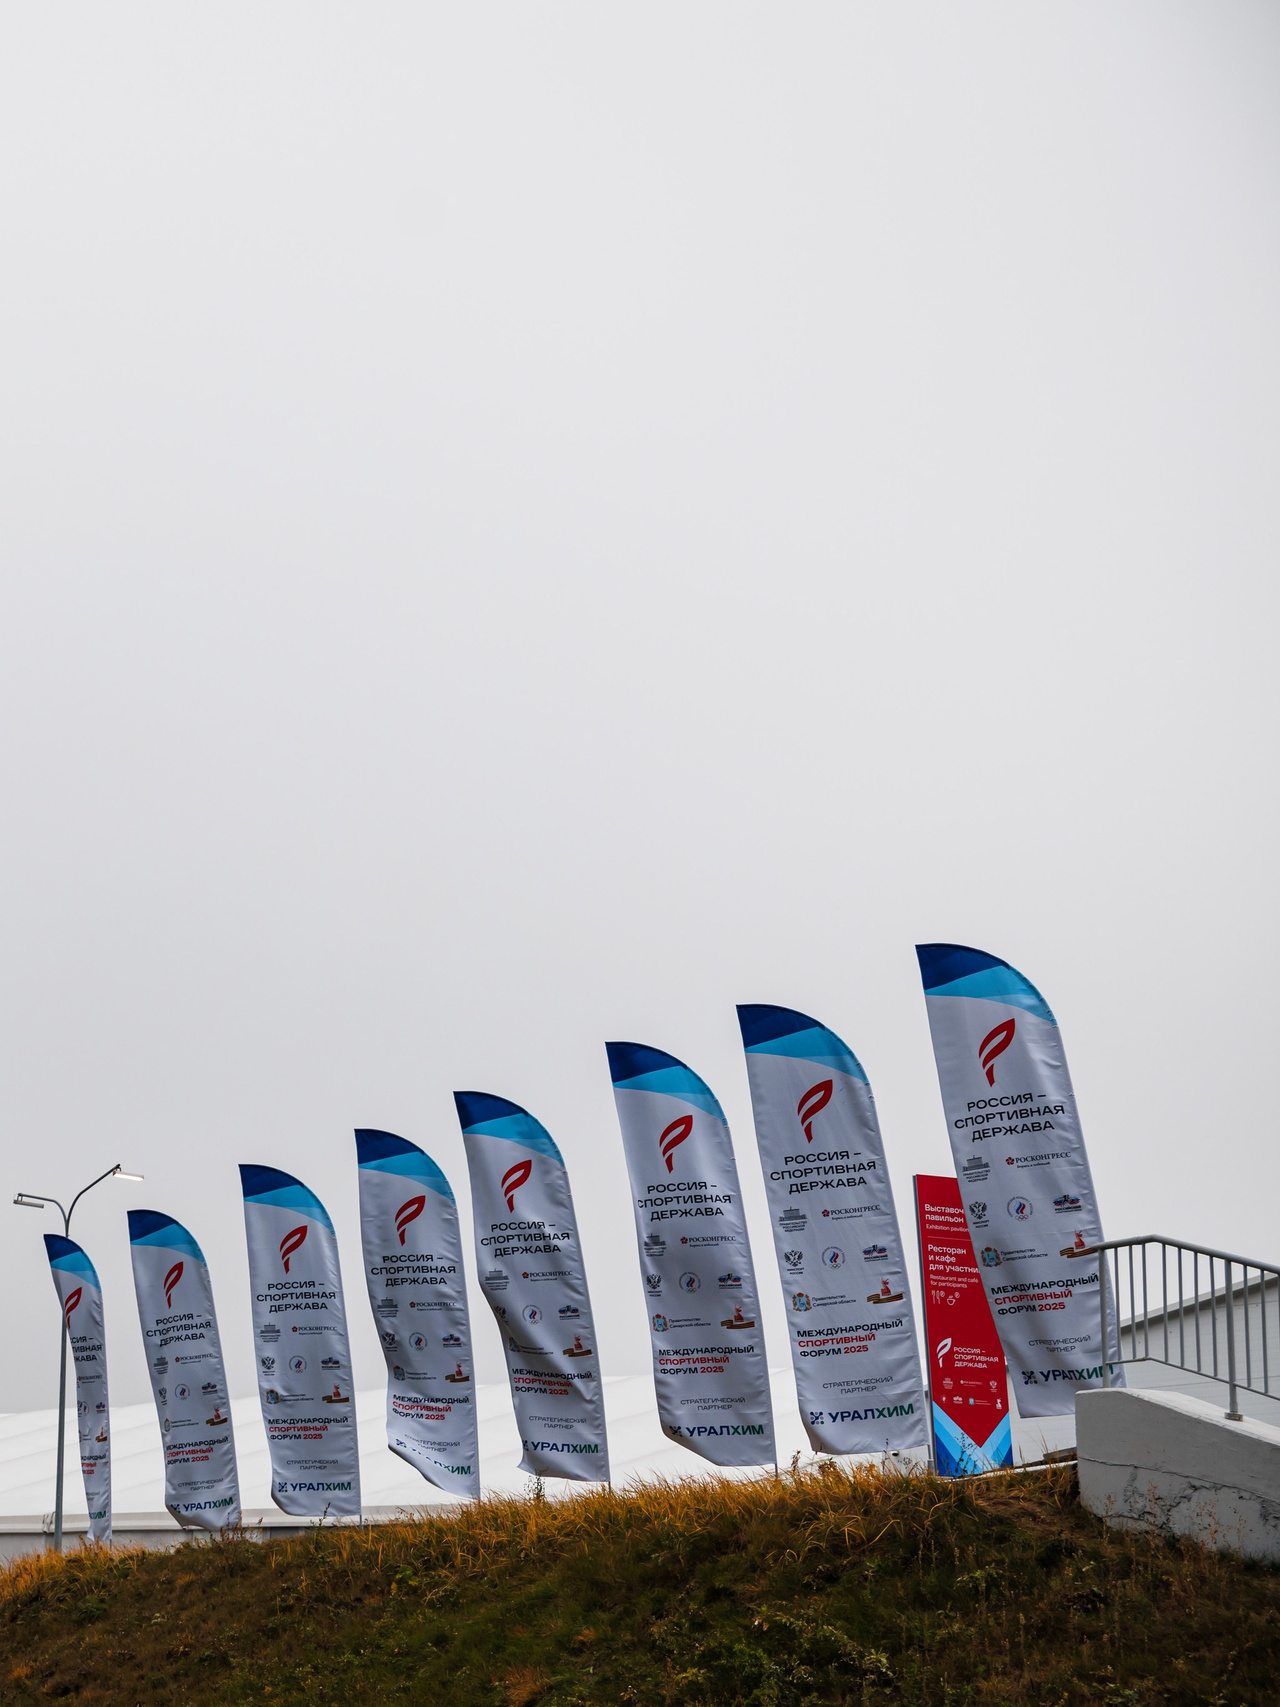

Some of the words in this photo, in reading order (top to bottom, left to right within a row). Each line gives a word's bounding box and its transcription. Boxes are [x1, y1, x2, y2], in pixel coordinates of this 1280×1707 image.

[967, 1093, 1033, 1112] РОССИЯ
[955, 1105, 1065, 1129] СПОРТИВНАЯ
[972, 1121, 1054, 1142] ДЕРЖАВА
[784, 1151, 849, 1165] РОССИЯ
[1016, 1152, 1071, 1163] РОСКОНГРЕСС
[770, 1161, 876, 1180] СПОРТИВНАЯ
[647, 1182, 707, 1194] РОССИЯ
[789, 1177, 867, 1195] ДЕРЖАВА
[638, 1195, 731, 1208] СПОРТИВНАЯ
[831, 1205, 880, 1215] РОСКОНГРЕСС
[925, 1204, 964, 1214] Выставоч
[651, 1208, 724, 1222] ДЕРЖАВА
[925, 1214, 963, 1223] павильон
[491, 1222, 545, 1232] РОССИЯ
[481, 1233, 570, 1246] СПОРТИВНАЯ
[494, 1245, 561, 1258] ДЕРЖАВА
[928, 1245, 966, 1255] Ресторан
[382, 1254, 433, 1263] РОССИЯ
[936, 1255, 956, 1263] кафе
[371, 1266, 456, 1275] СПОРТИВНАЯ
[945, 1265, 979, 1273] участни
[268, 1281, 315, 1291] РОССИЯ
[386, 1277, 447, 1287] ДЕРЖАВА
[991, 1273, 1099, 1295] МЕЖДУНАРОДНЫЙ
[257, 1292, 336, 1302] СПОРТИВНАЯ
[994, 1289, 1072, 1305] СПОРТИВНЫЙ
[269, 1302, 328, 1313] ДЕРЖАВА
[997, 1305, 1037, 1316] ФОРУМ
[1038, 1302, 1065, 1311] 2025
[156, 1313, 193, 1326] РОССИЯ
[146, 1321, 211, 1337] СПОРТИВНАЯ
[797, 1319, 903, 1338] МЕЖДУНАРОДНЫЙ
[160, 1333, 205, 1347] ДЕРЖАВА
[798, 1333, 875, 1348] СПОРТИВНЫЙ
[659, 1345, 754, 1356] МЕЖДУНАРОДНЫЙ
[800, 1348, 842, 1357] ФОРУМ
[844, 1345, 869, 1354] 2025
[659, 1355, 729, 1366] СПОРТИВНЫЙ
[954, 1354, 998, 1362] СПОРТИВНАЯ
[660, 1367, 698, 1375] ФОРУМ
[823, 1376, 893, 1389] СТРАТЕГИЧЕСКИЙ
[841, 1386, 877, 1394] ПАРТНЕР
[393, 1394, 469, 1404] МЕЖДУНАРОДНЫЙ
[681, 1397, 746, 1405] СТРАТЕГИЧЕСКИЙ
[393, 1401, 451, 1412] СПОРТИВНЫЙ
[392, 1408, 423, 1419] ФОРУМ
[828, 1404, 914, 1423] УРАЛХИМ
[268, 1416, 348, 1425] МЕЖДУНАРОДНЫЙ
[686, 1425, 764, 1437] УРАЛХИМ
[531, 1441, 598, 1453] УРАЛХИМ
[291, 1482, 351, 1491] УРАЛХИМ
[183, 1497, 233, 1512] УРАЛХИМ
